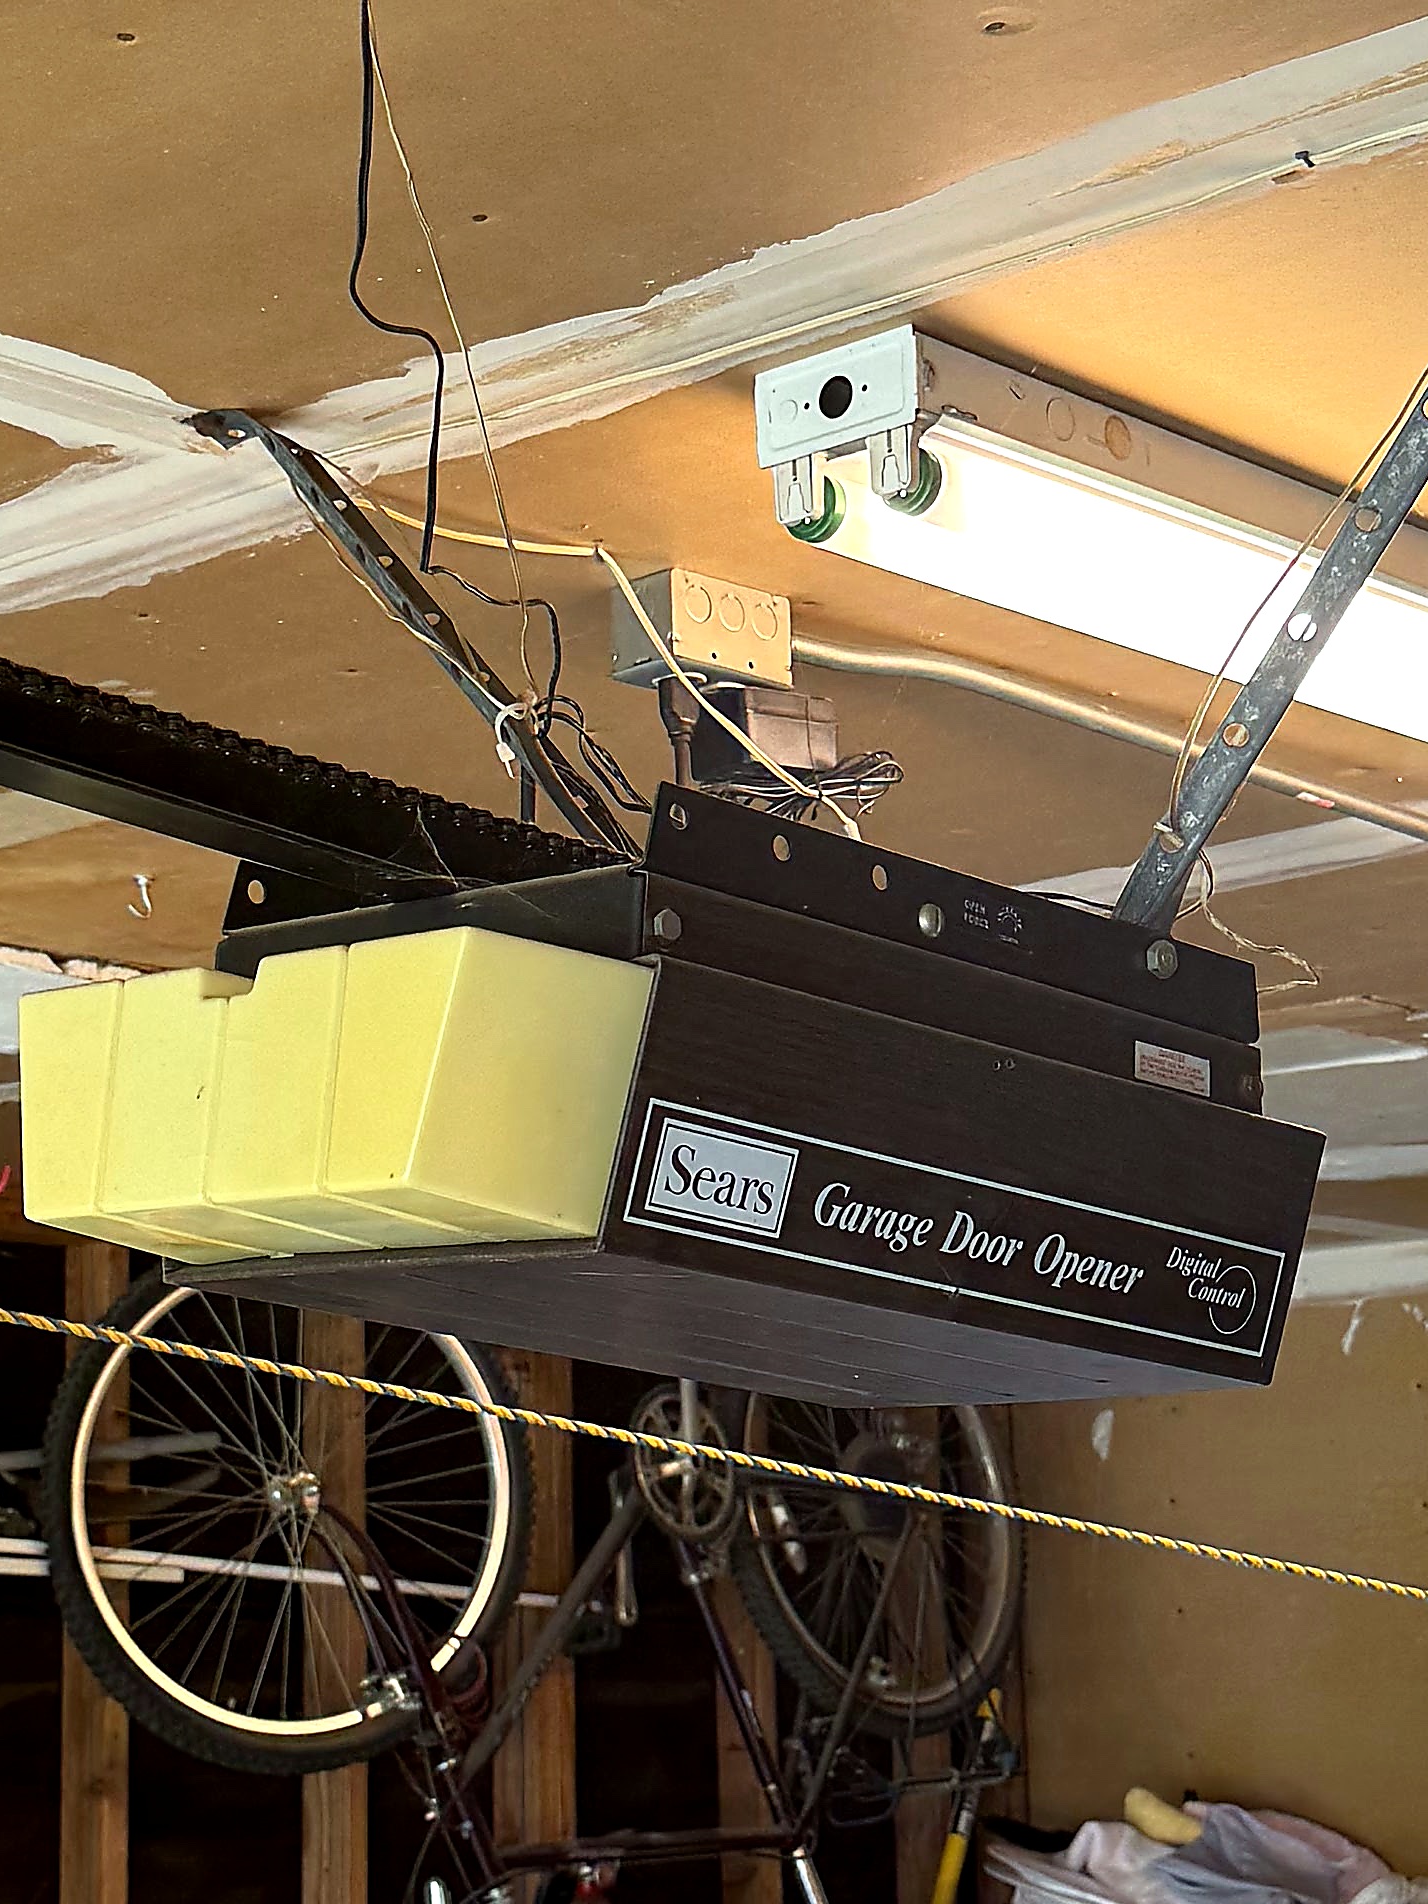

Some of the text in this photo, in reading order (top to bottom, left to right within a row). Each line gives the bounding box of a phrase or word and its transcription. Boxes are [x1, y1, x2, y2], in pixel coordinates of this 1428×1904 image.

[664, 1144, 774, 1215] Sears
[814, 1182, 1145, 1295] Garage Door Opener
[1167, 1246, 1222, 1280] Digital
[1188, 1278, 1247, 1309] Control
